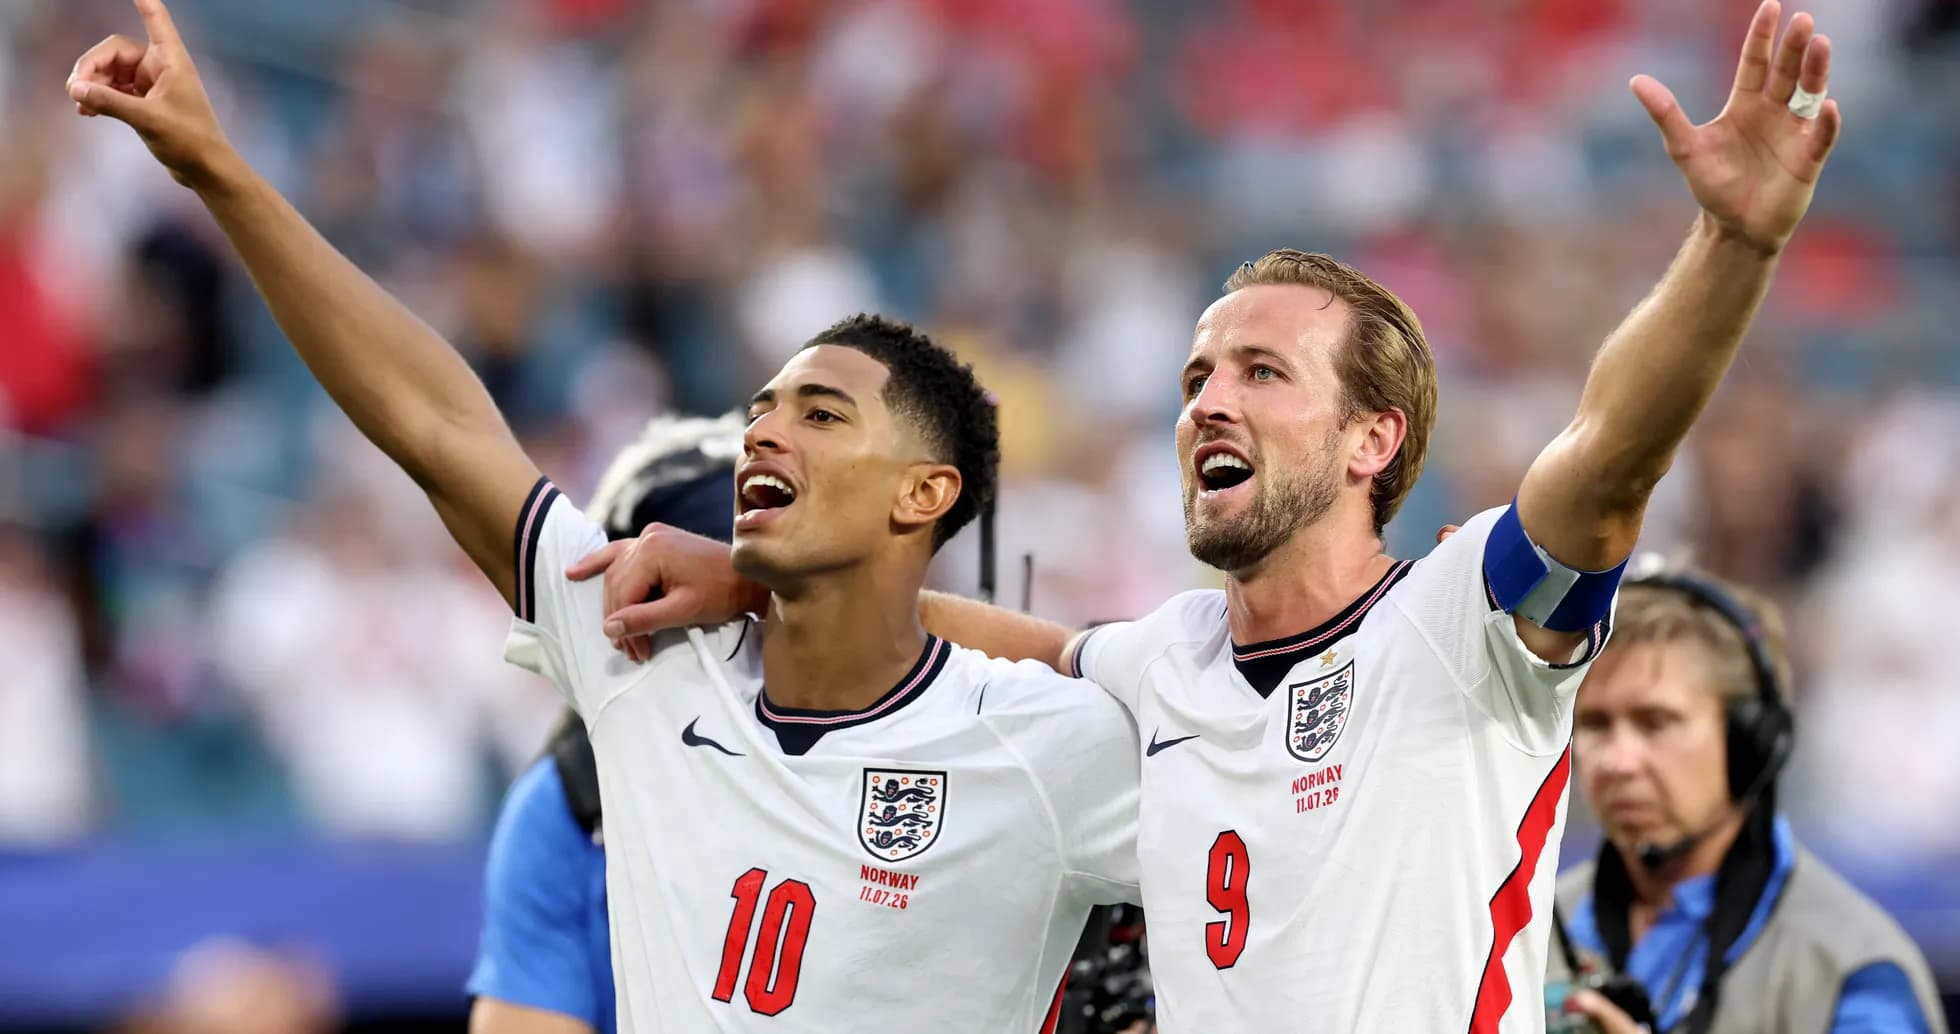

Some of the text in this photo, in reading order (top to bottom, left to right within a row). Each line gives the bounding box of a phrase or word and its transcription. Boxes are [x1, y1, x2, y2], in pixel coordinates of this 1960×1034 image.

[1291, 763, 1343, 795] NORWAY
[1296, 786, 1341, 814] 11.07.26
[860, 864, 919, 891] NORWAY
[859, 885, 909, 911] 11.07.26
[1205, 830, 1251, 970] 9
[711, 867, 817, 1017] 10
